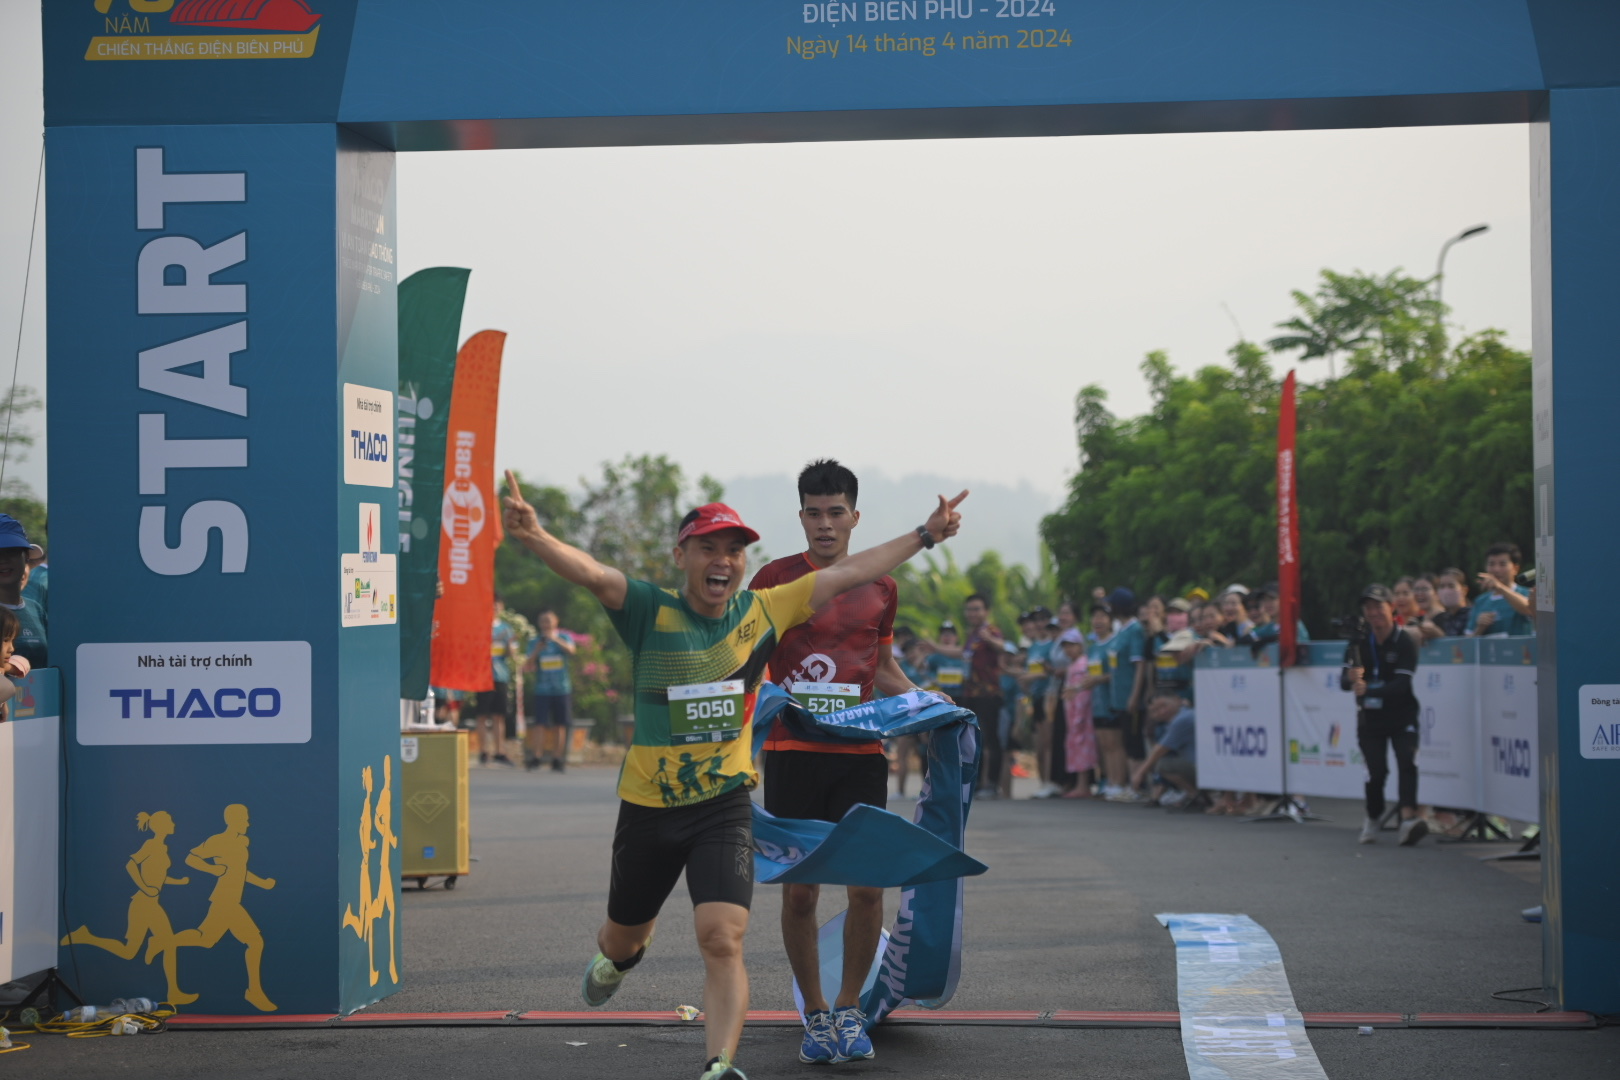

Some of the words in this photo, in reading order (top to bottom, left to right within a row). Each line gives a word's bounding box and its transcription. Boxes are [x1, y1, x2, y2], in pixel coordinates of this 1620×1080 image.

[995, 0, 1056, 18] 2024
[105, 12, 150, 34] NĂM
[97, 40, 140, 56] CHIẾN
[144, 39, 195, 55] THẮNG
[198, 41, 233, 58] ĐIỆN
[236, 39, 270, 55] BIÊN
[274, 38, 304, 54] PHỦ
[786, 36, 839, 60] Ngày
[846, 34, 868, 53] 14
[874, 32, 936, 57] tháng
[941, 31, 956, 50] 4
[962, 30, 1009, 50] năm
[1016, 28, 1072, 48] 2024
[136, 147, 249, 576] START
[351, 430, 388, 463] THACO
[137, 654, 165, 668] Nhà
[169, 654, 187, 668] tài
[190, 655, 212, 670] trợ
[215, 653, 253, 668] chính
[109, 687, 282, 719] THACO
[686, 698, 736, 721] 5050
[807, 697, 846, 713] 5219
[1212, 725, 1268, 757] THACO
